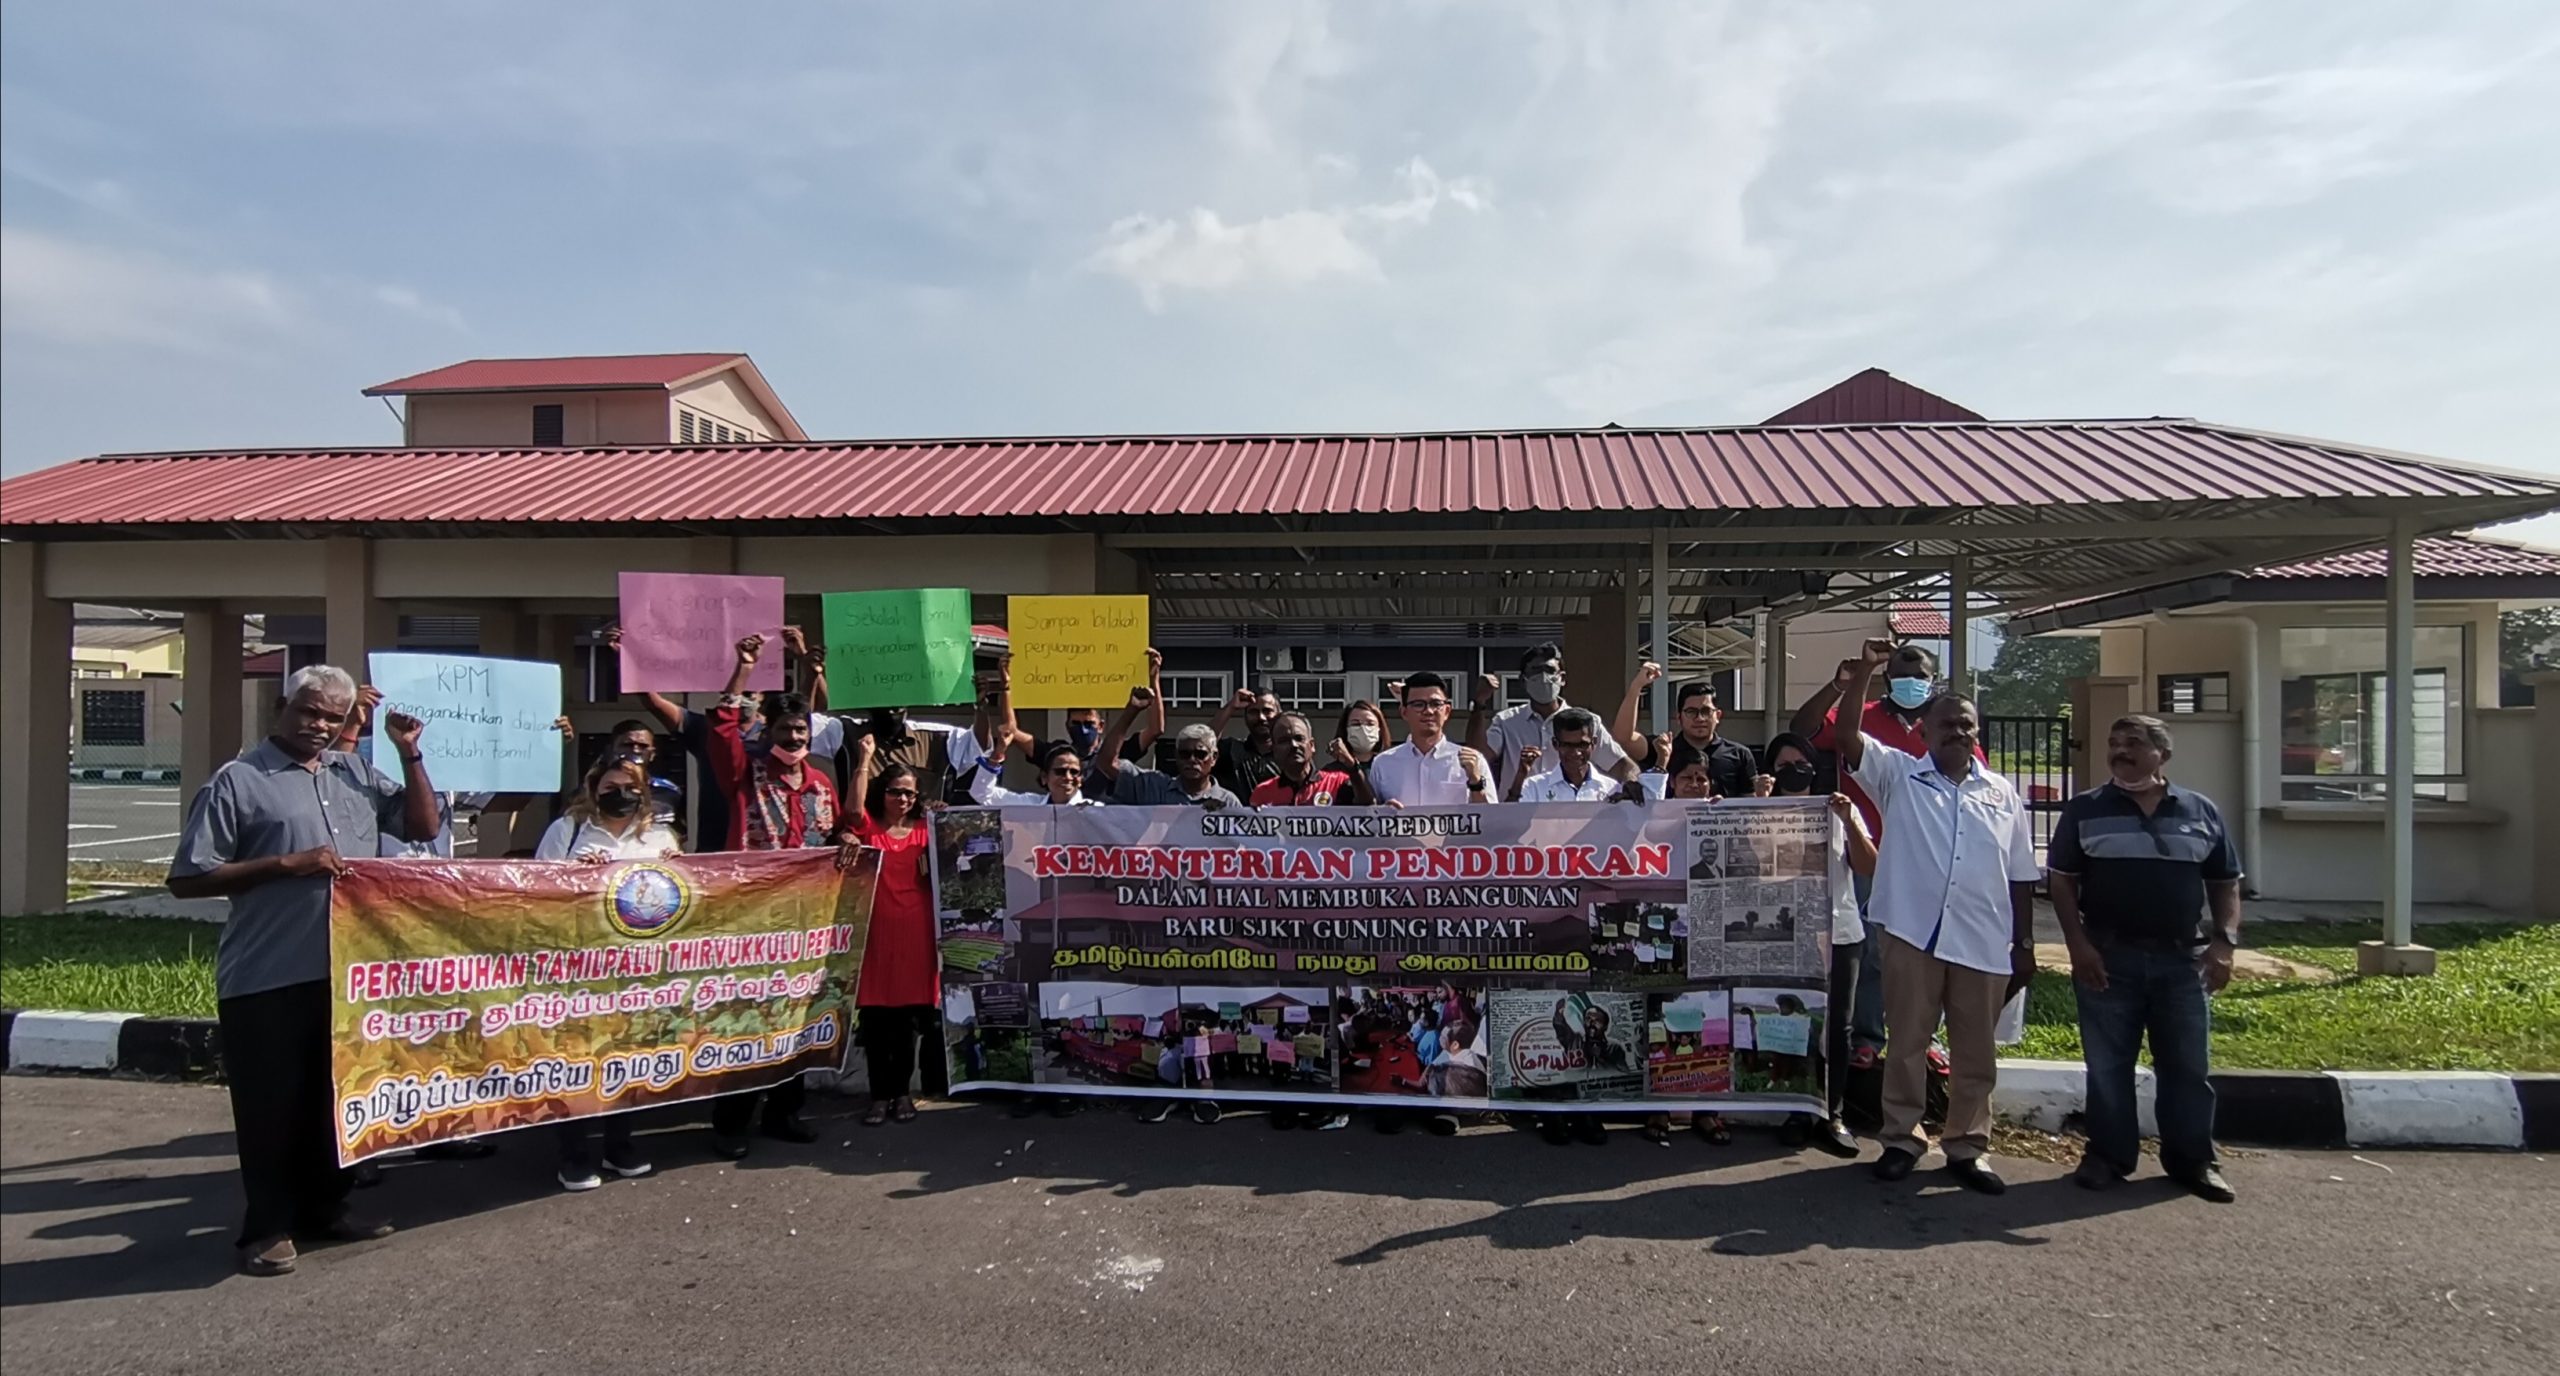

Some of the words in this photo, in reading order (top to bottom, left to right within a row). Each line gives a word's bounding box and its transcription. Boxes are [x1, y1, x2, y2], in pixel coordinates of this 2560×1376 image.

[436, 662, 490, 697] KPM
[1024, 665, 1056, 685] akan
[1202, 814, 1280, 836] SIKAP
[1286, 815, 1374, 837] TIDAK
[1379, 814, 1481, 837] PEDULI
[1032, 845, 1355, 880] KEMENTERIAN
[1366, 844, 1673, 880] PENDIDIKAN
[1117, 885, 1208, 907] DALAM
[1217, 886, 1270, 908] HAL
[1278, 887, 1419, 908] MEMBUKA
[1424, 886, 1580, 907] BANGUNAN
[1165, 917, 1235, 938] BARU
[1243, 918, 1305, 939] SJKT
[1313, 919, 1427, 939] GUNUNG
[1436, 918, 1534, 939] RAPAT.
[348, 953, 528, 1002] PERTUBUHAN
[534, 943, 662, 985] TAMILPALLI
[667, 930, 803, 972] THIRVUKKULU
[1051, 946, 1277, 971] தமிழ்ப்பள்ளியே
[1296, 951, 1377, 976] நமது
[1398, 950, 1590, 973] அடையாளம்
[482, 979, 689, 1035] தமிழ்ப்பள்ளி
[344, 1060, 592, 1140] தமிழ்ப்பள்ளியே
[604, 1049, 682, 1094] நமது
